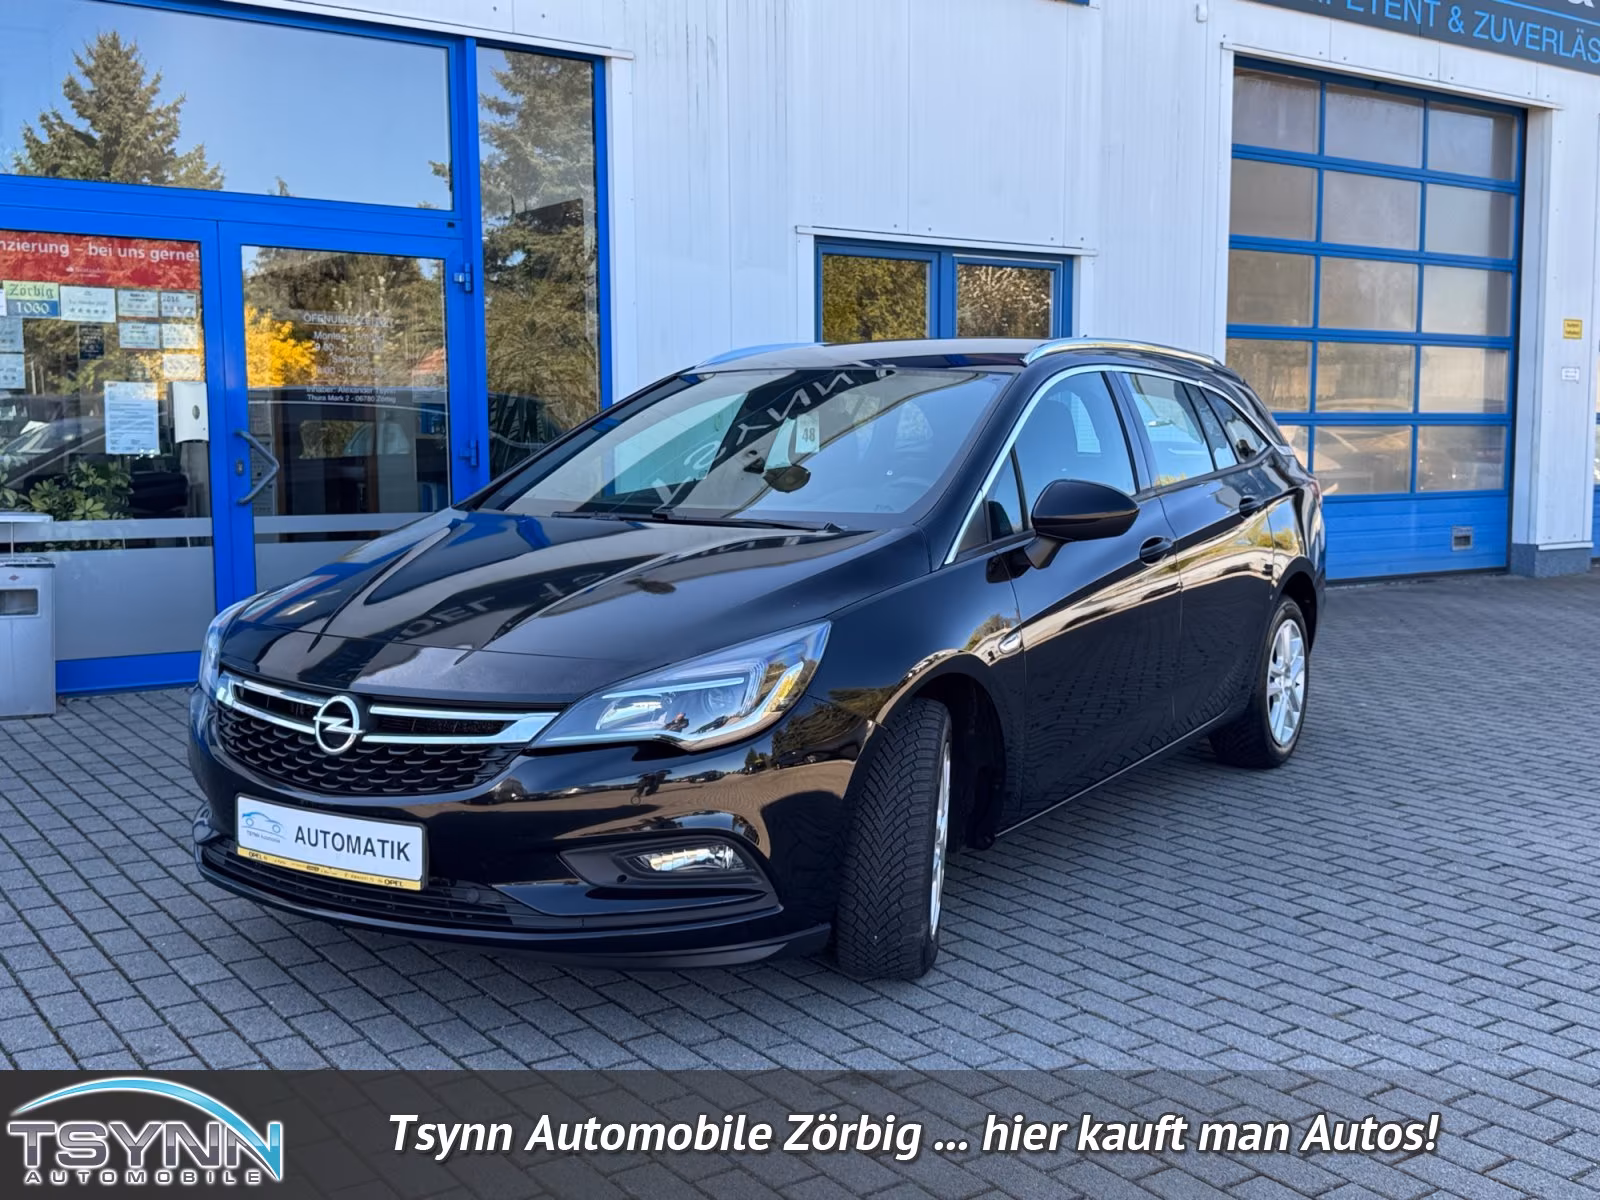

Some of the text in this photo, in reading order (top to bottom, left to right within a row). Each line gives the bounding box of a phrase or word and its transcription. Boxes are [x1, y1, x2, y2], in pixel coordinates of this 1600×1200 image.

[1448, 5, 1465, 34] &
[1472, 10, 1600, 63] ZUVERLÄS
[88, 242, 113, 257] bei
[117, 247, 145, 259] uns
[149, 248, 200, 263] gerne!
[10, 283, 55, 299] Zörbig
[801, 427, 816, 443] 48
[295, 825, 410, 861] AUTOMATIK
